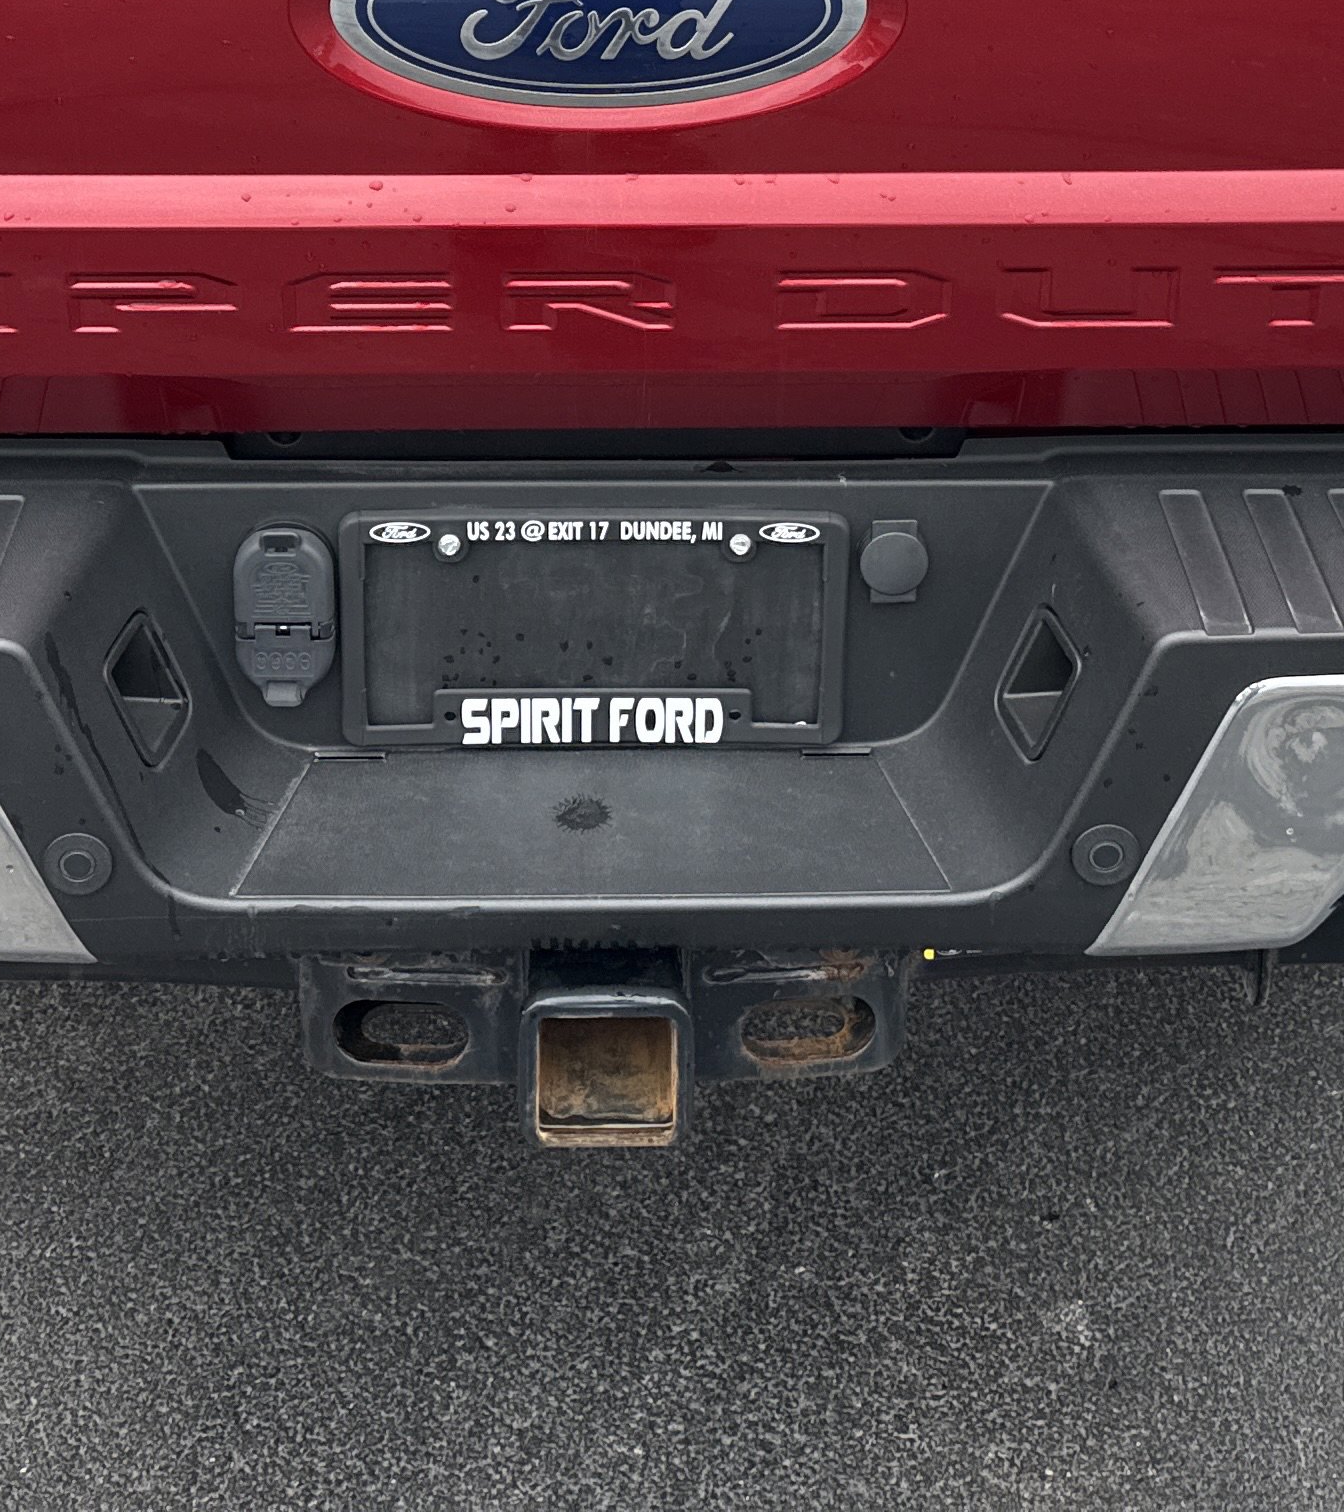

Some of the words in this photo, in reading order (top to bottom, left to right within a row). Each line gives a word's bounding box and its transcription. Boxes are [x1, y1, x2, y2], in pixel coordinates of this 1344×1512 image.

[466, 521, 490, 541] US
[494, 520, 516, 541] 23
[588, 520, 610, 541] 17
[620, 520, 697, 544] DUNDEE,
[701, 521, 724, 541] MI
[461, 697, 601, 745] SPIRIT
[609, 697, 724, 744] FORD
